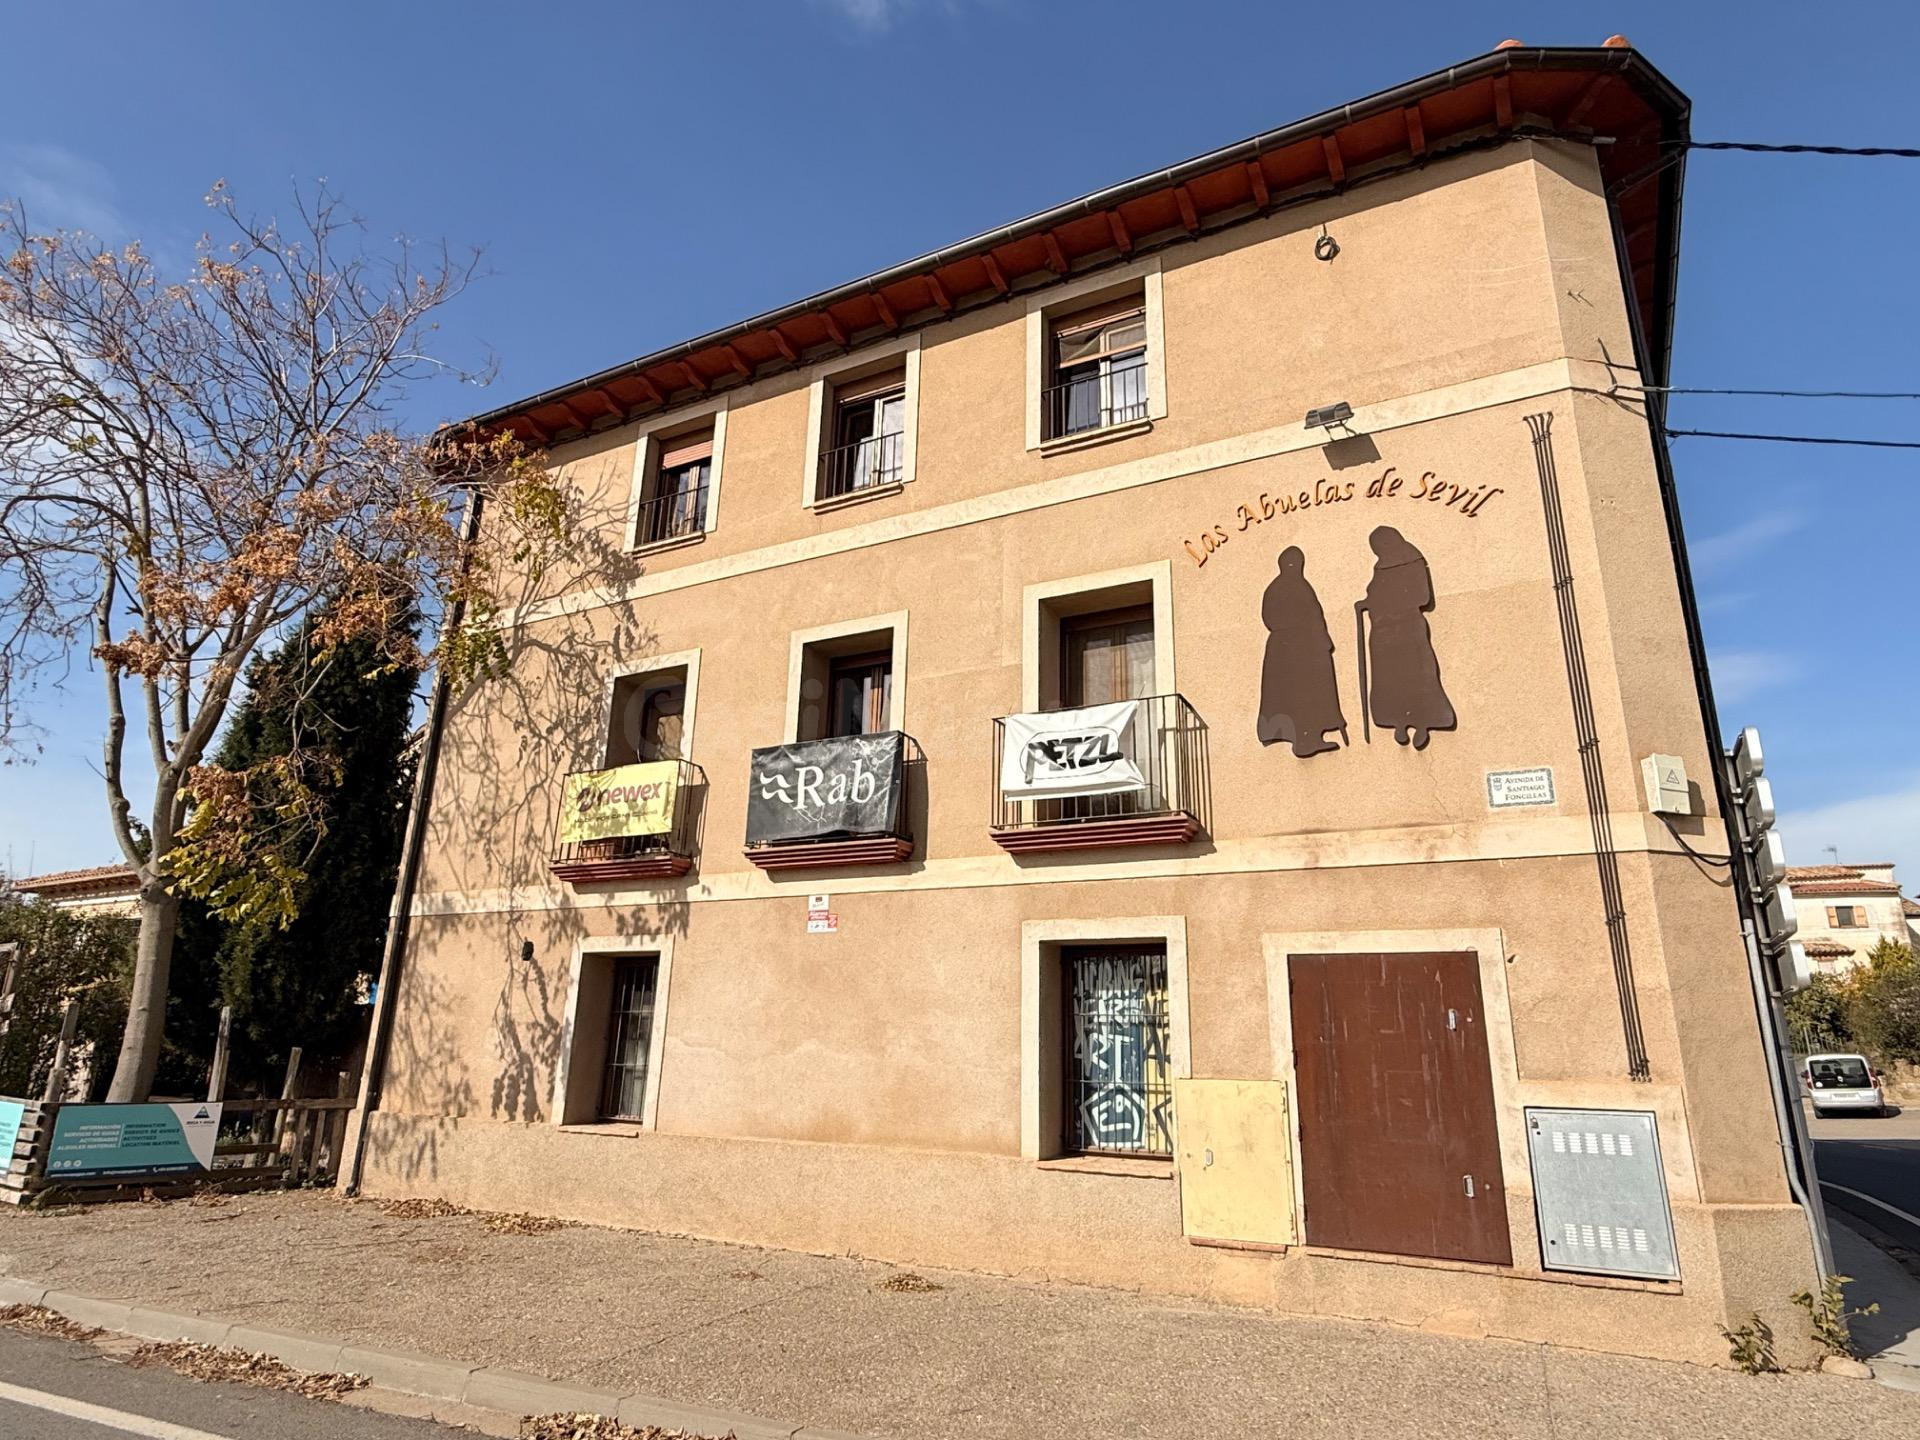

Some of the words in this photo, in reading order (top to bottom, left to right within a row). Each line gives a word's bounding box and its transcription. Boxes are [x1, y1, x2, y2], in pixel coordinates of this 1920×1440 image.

[1183, 525, 1230, 568] Las
[1237, 478, 1355, 532] Abuelas
[1366, 466, 1403, 498] de
[1024, 734, 1124, 785] PETZL
[793, 758, 876, 810] Rab
[1505, 776, 1534, 784] AVENIDA
[1506, 784, 1545, 793] SANTIAGO
[1505, 792, 1548, 801] FONCILLAS
